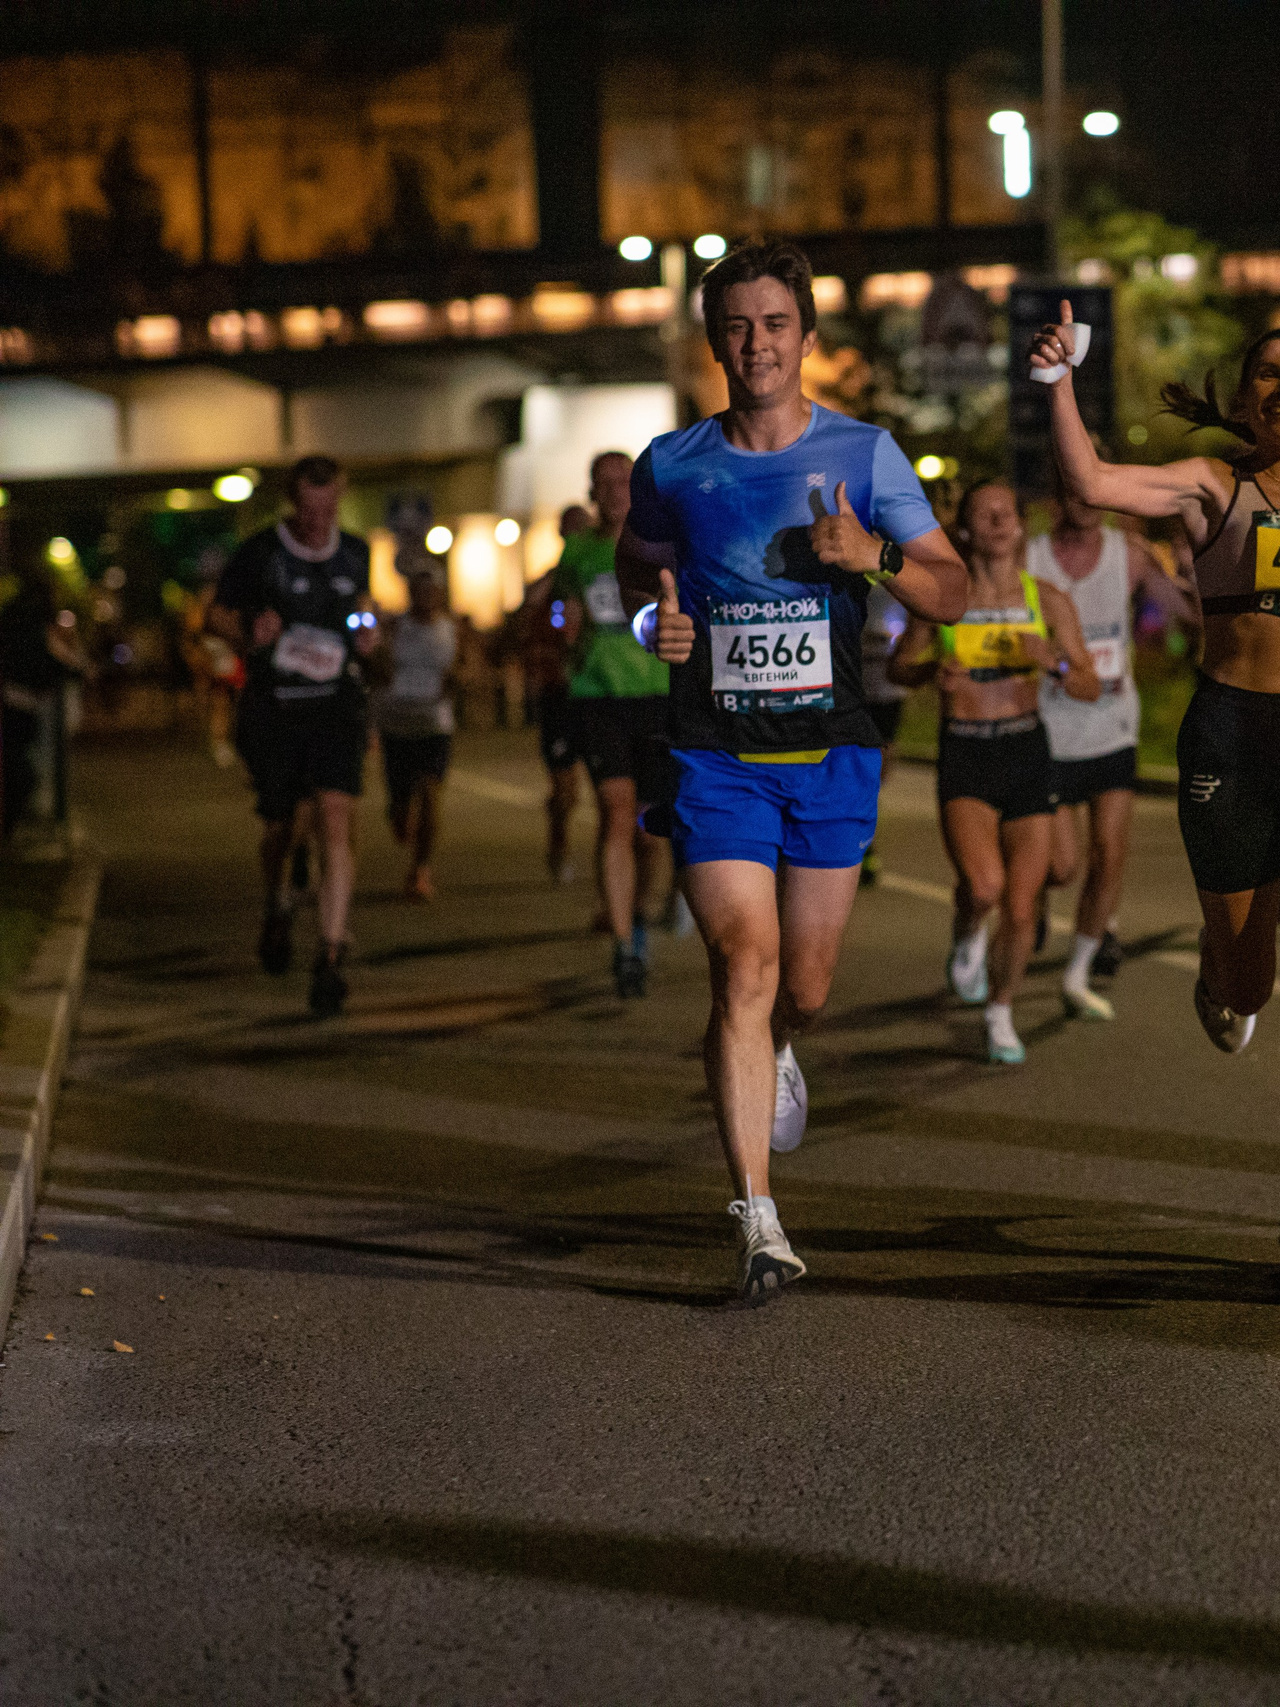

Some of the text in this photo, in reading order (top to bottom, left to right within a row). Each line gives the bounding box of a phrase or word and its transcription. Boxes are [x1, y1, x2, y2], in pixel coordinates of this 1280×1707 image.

[719, 597, 821, 620] НОЧНОЙ
[726, 632, 817, 669] 4566
[744, 669, 799, 683] ЕВГЕНИЙ
